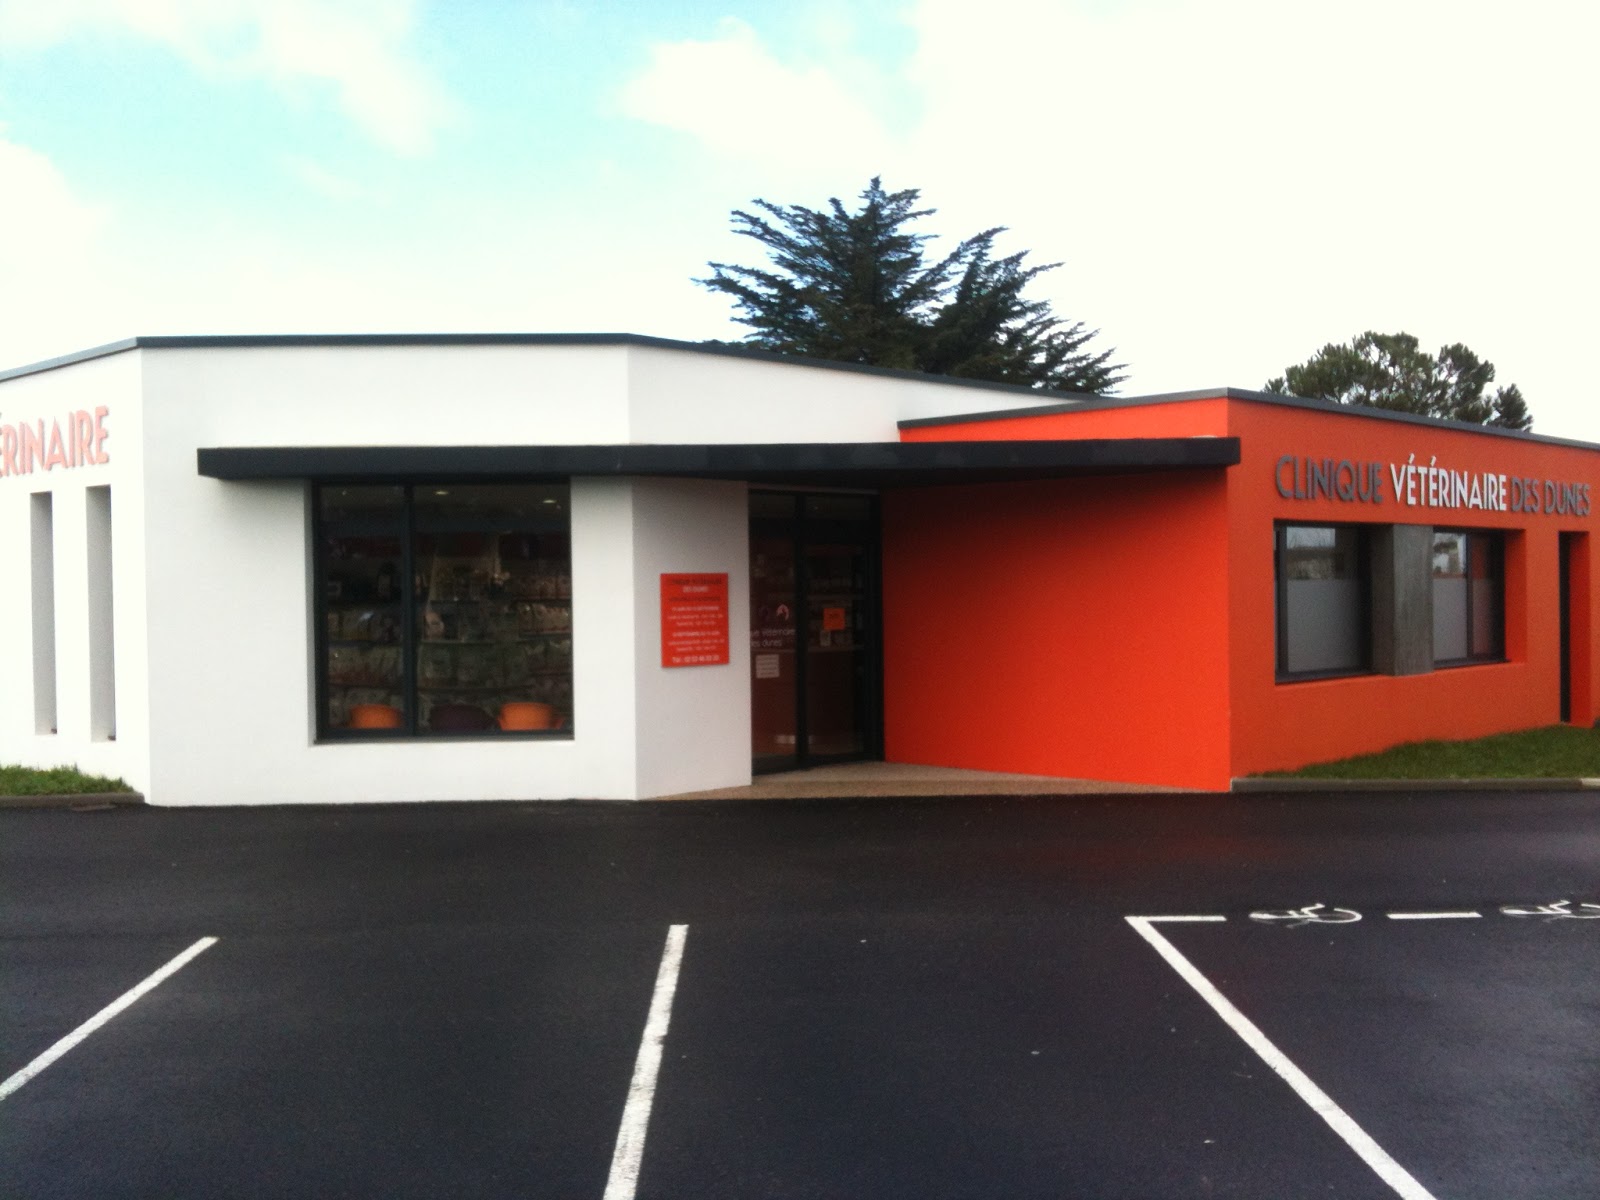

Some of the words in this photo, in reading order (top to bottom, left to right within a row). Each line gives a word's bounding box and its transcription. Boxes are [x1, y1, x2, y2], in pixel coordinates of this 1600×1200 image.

[0, 405, 109, 478] RINAIRE
[1275, 453, 1384, 504] CLINIQUE
[1390, 453, 1507, 511] VÉTÉRINAIRE
[1511, 476, 1540, 513] DES
[1544, 480, 1591, 517] DUNES
